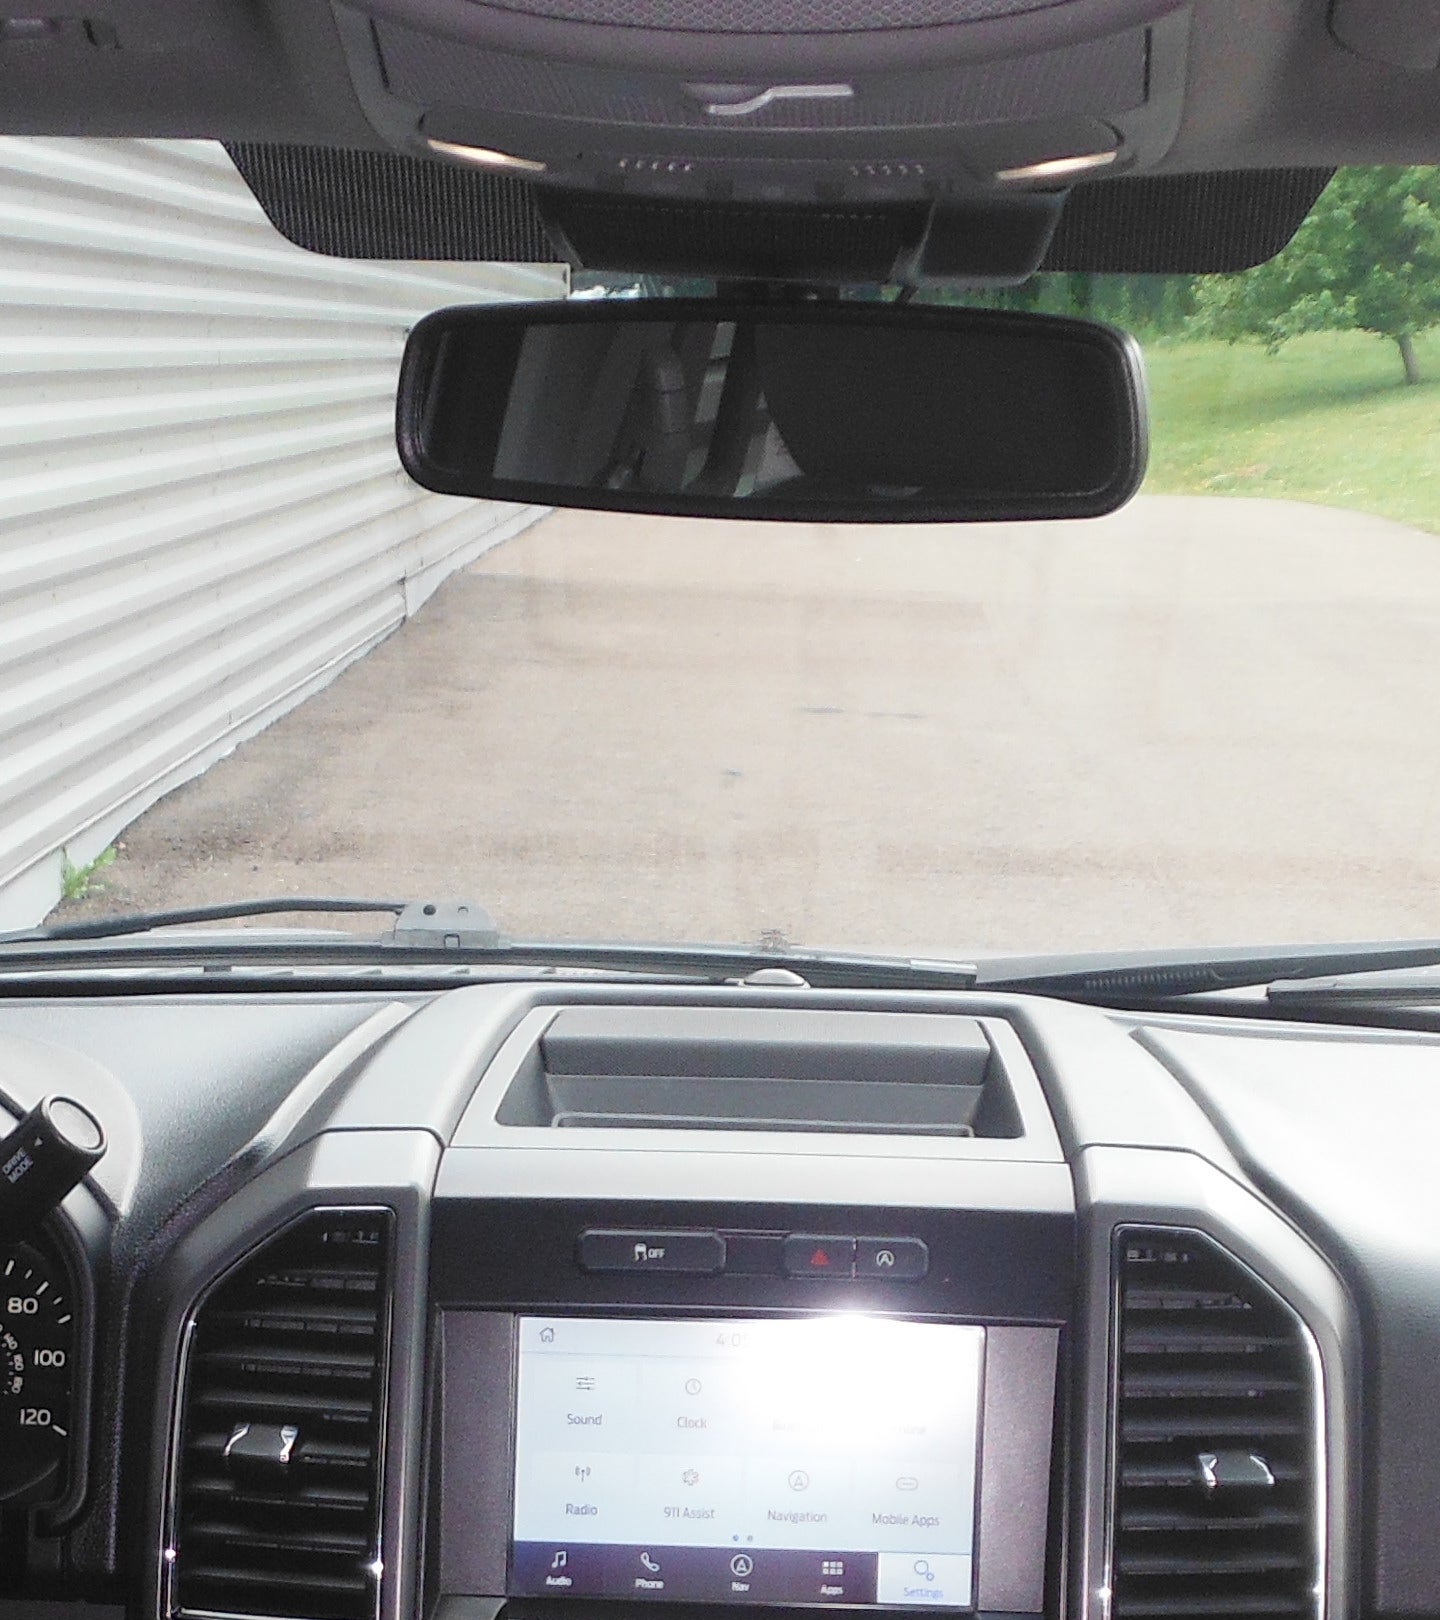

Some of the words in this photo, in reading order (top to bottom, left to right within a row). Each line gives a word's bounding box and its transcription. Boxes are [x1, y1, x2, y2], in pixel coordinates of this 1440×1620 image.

[2, 1147, 27, 1175] DRIVE
[8, 1155, 34, 1184] MODE
[648, 1248, 666, 1259] OFF
[7, 1297, 39, 1314] 80
[34, 1349, 66, 1367] 100
[20, 1408, 51, 1425] 120
[567, 1413, 602, 1425] Sound
[677, 1416, 707, 1428] Clock
[565, 1503, 598, 1515] Radio
[664, 1506, 680, 1518] 911
[683, 1507, 715, 1519] Assist
[767, 1509, 828, 1523] Navigation
[872, 1513, 909, 1525] Mobile
[911, 1514, 941, 1528] Apps
[546, 1576, 573, 1587] Audio
[635, 1578, 665, 1590] Phone
[731, 1581, 750, 1592] Nav
[820, 1584, 844, 1596] Apps
[904, 1587, 944, 1600] Settings
